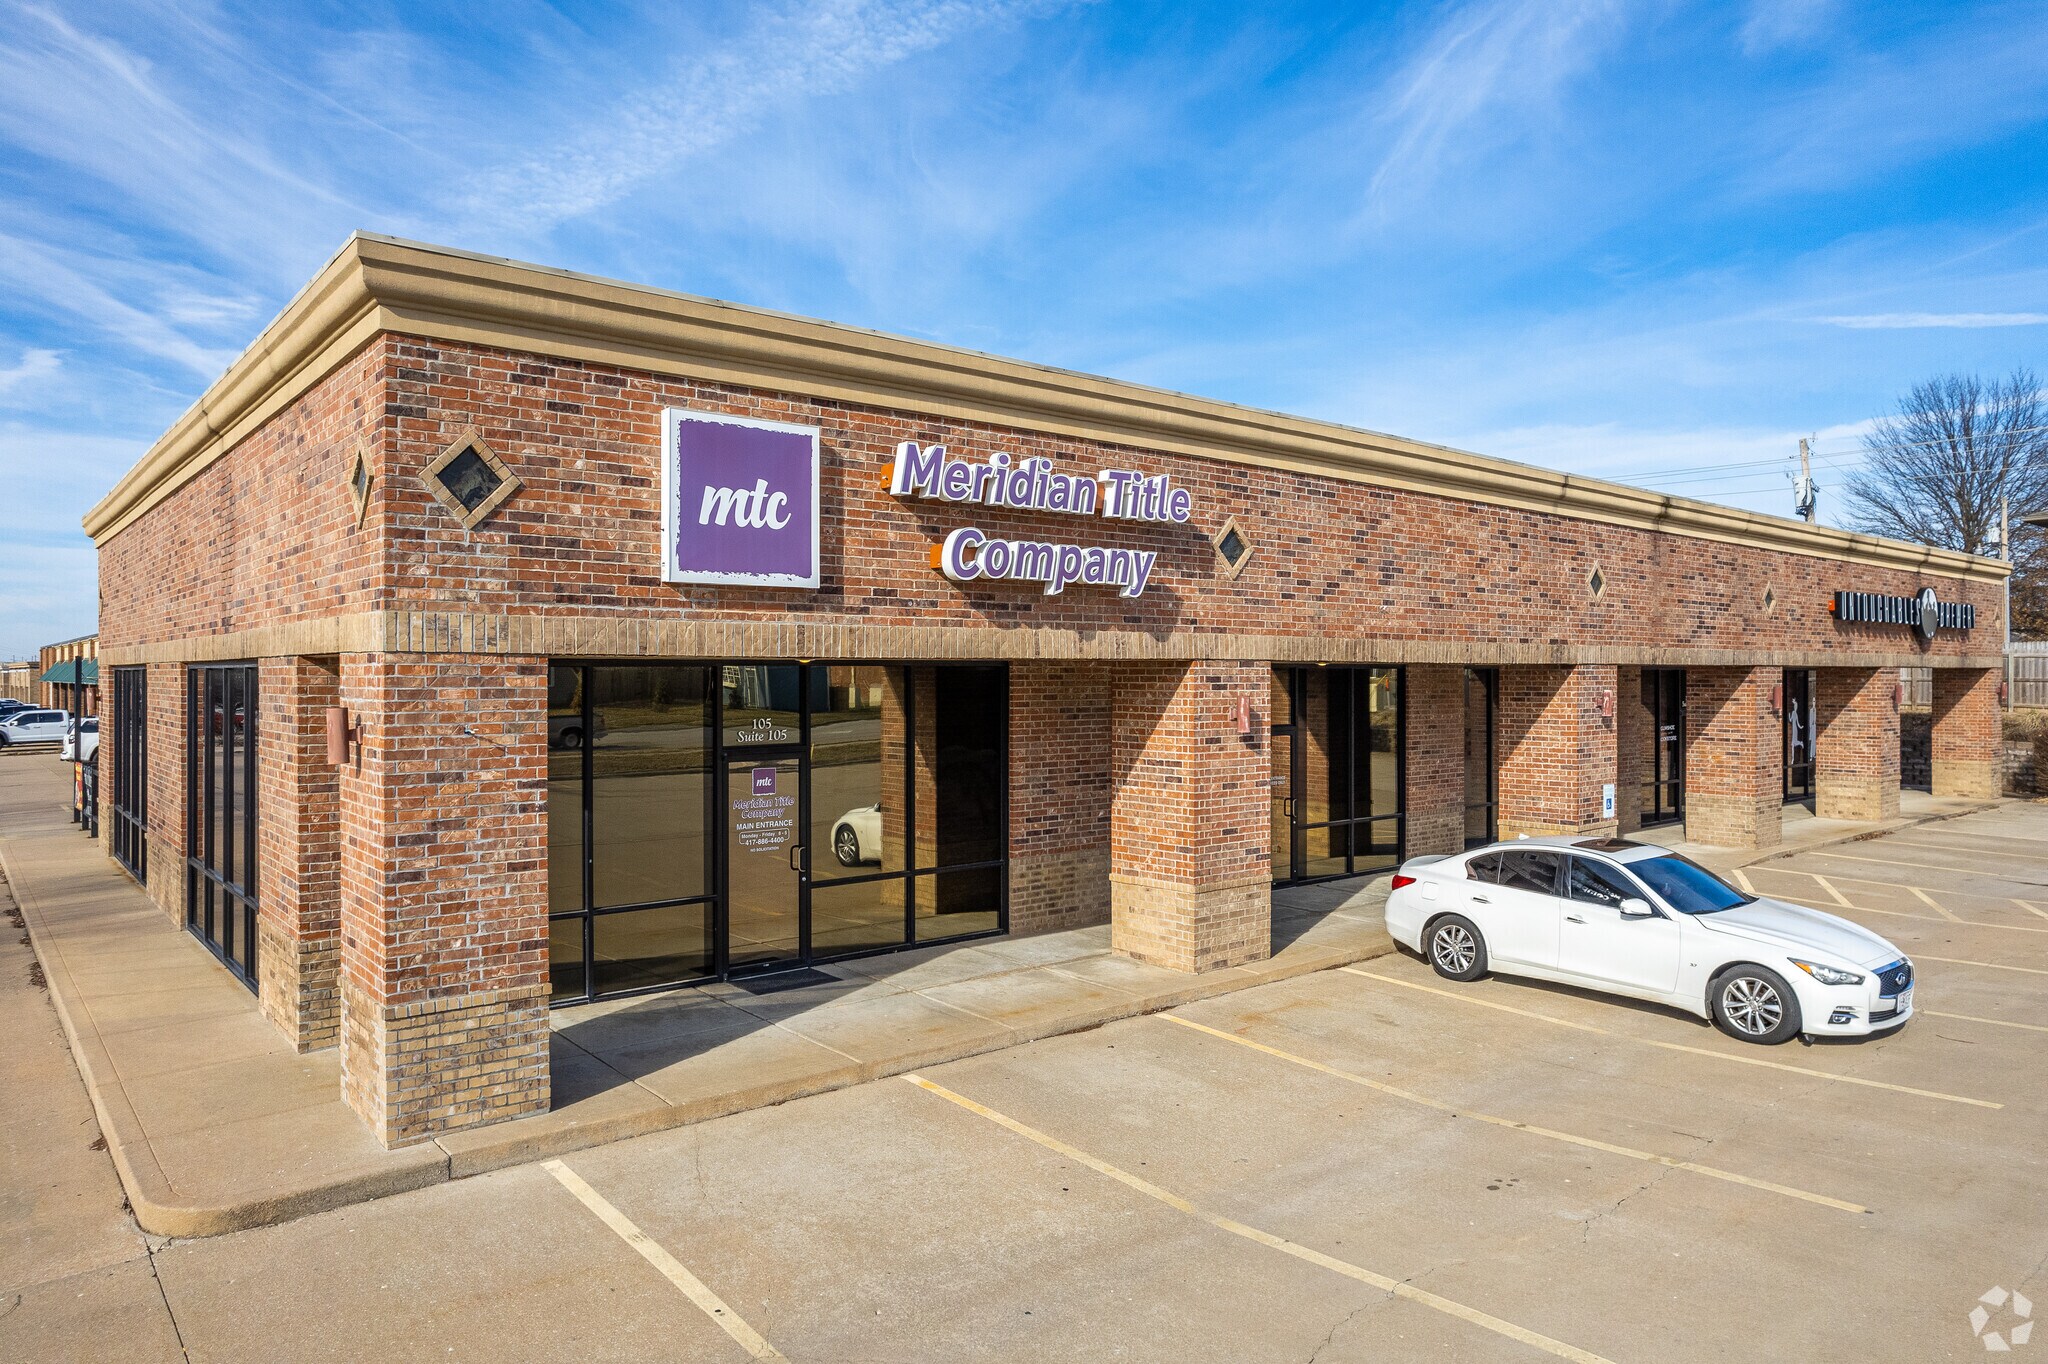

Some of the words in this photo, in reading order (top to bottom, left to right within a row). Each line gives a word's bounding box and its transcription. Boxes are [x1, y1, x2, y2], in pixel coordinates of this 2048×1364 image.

[890, 441, 1098, 515] Meridian
[1099, 468, 1192, 524] Title
[699, 478, 792, 530] mtc
[941, 526, 1158, 598] Company
[1841, 591, 1920, 625] UNTOUCHABLES
[752, 717, 772, 730] 105
[736, 730, 764, 743] Suite
[768, 728, 788, 741] 105
[732, 797, 773, 810] Meridian
[774, 795, 795, 807] Title
[741, 807, 785, 819] Company
[755, 819, 793, 829] ENTRANCE
